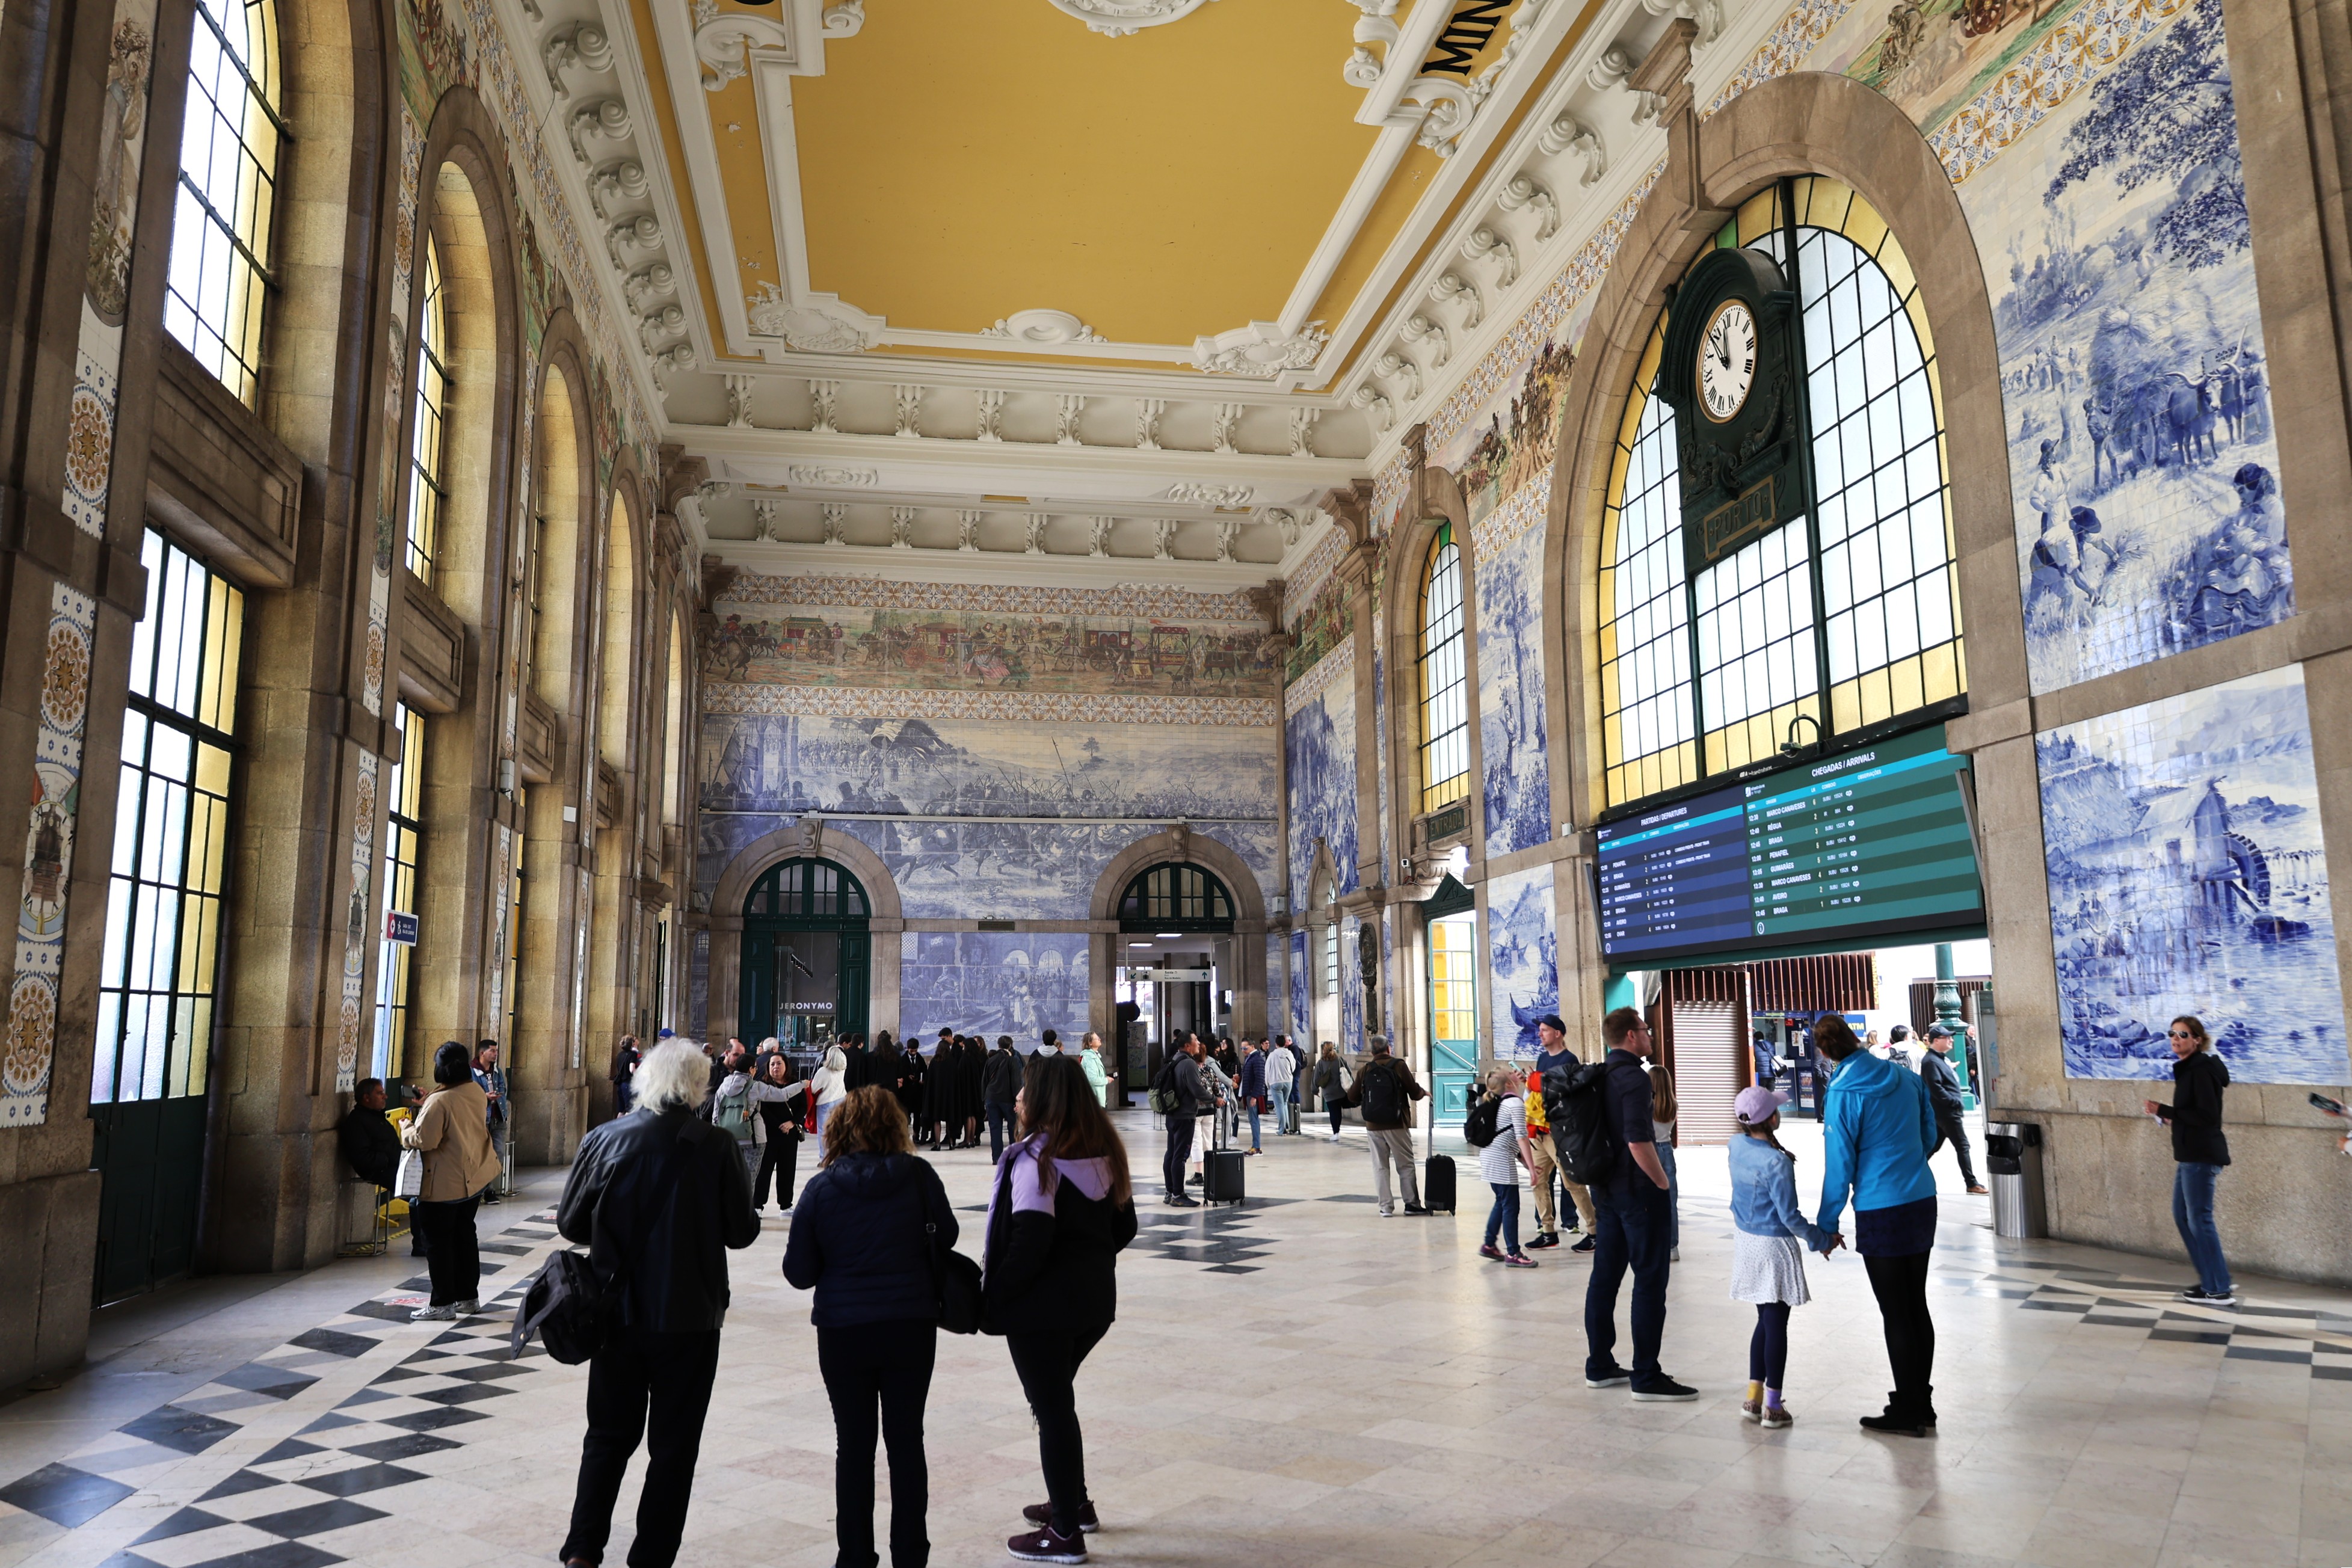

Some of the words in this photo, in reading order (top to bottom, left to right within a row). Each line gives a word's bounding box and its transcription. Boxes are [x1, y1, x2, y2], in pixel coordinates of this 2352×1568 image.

[1714, 491, 1761, 541] PORTO
[1812, 761, 1843, 777] CHEGADAS
[1846, 752, 1875, 767] ARRIVALS
[1641, 816, 1659, 826] PARTIDAS
[1661, 807, 1687, 820] DEPARTURES
[1766, 808, 1781, 817] MARCO
[1781, 802, 1806, 813] CANAVESES
[1430, 811, 1462, 837] ENTRADA
[1767, 822, 1782, 831] RÉGUA
[1769, 836, 1783, 845] BRAGA
[1769, 849, 1789, 859] PENAFIEL
[1770, 862, 1794, 873] GUIMARÃES
[1771, 878, 1786, 887] MARCO
[1786, 873, 1811, 884] CANAVESES
[1772, 892, 1787, 900] AVEIRO
